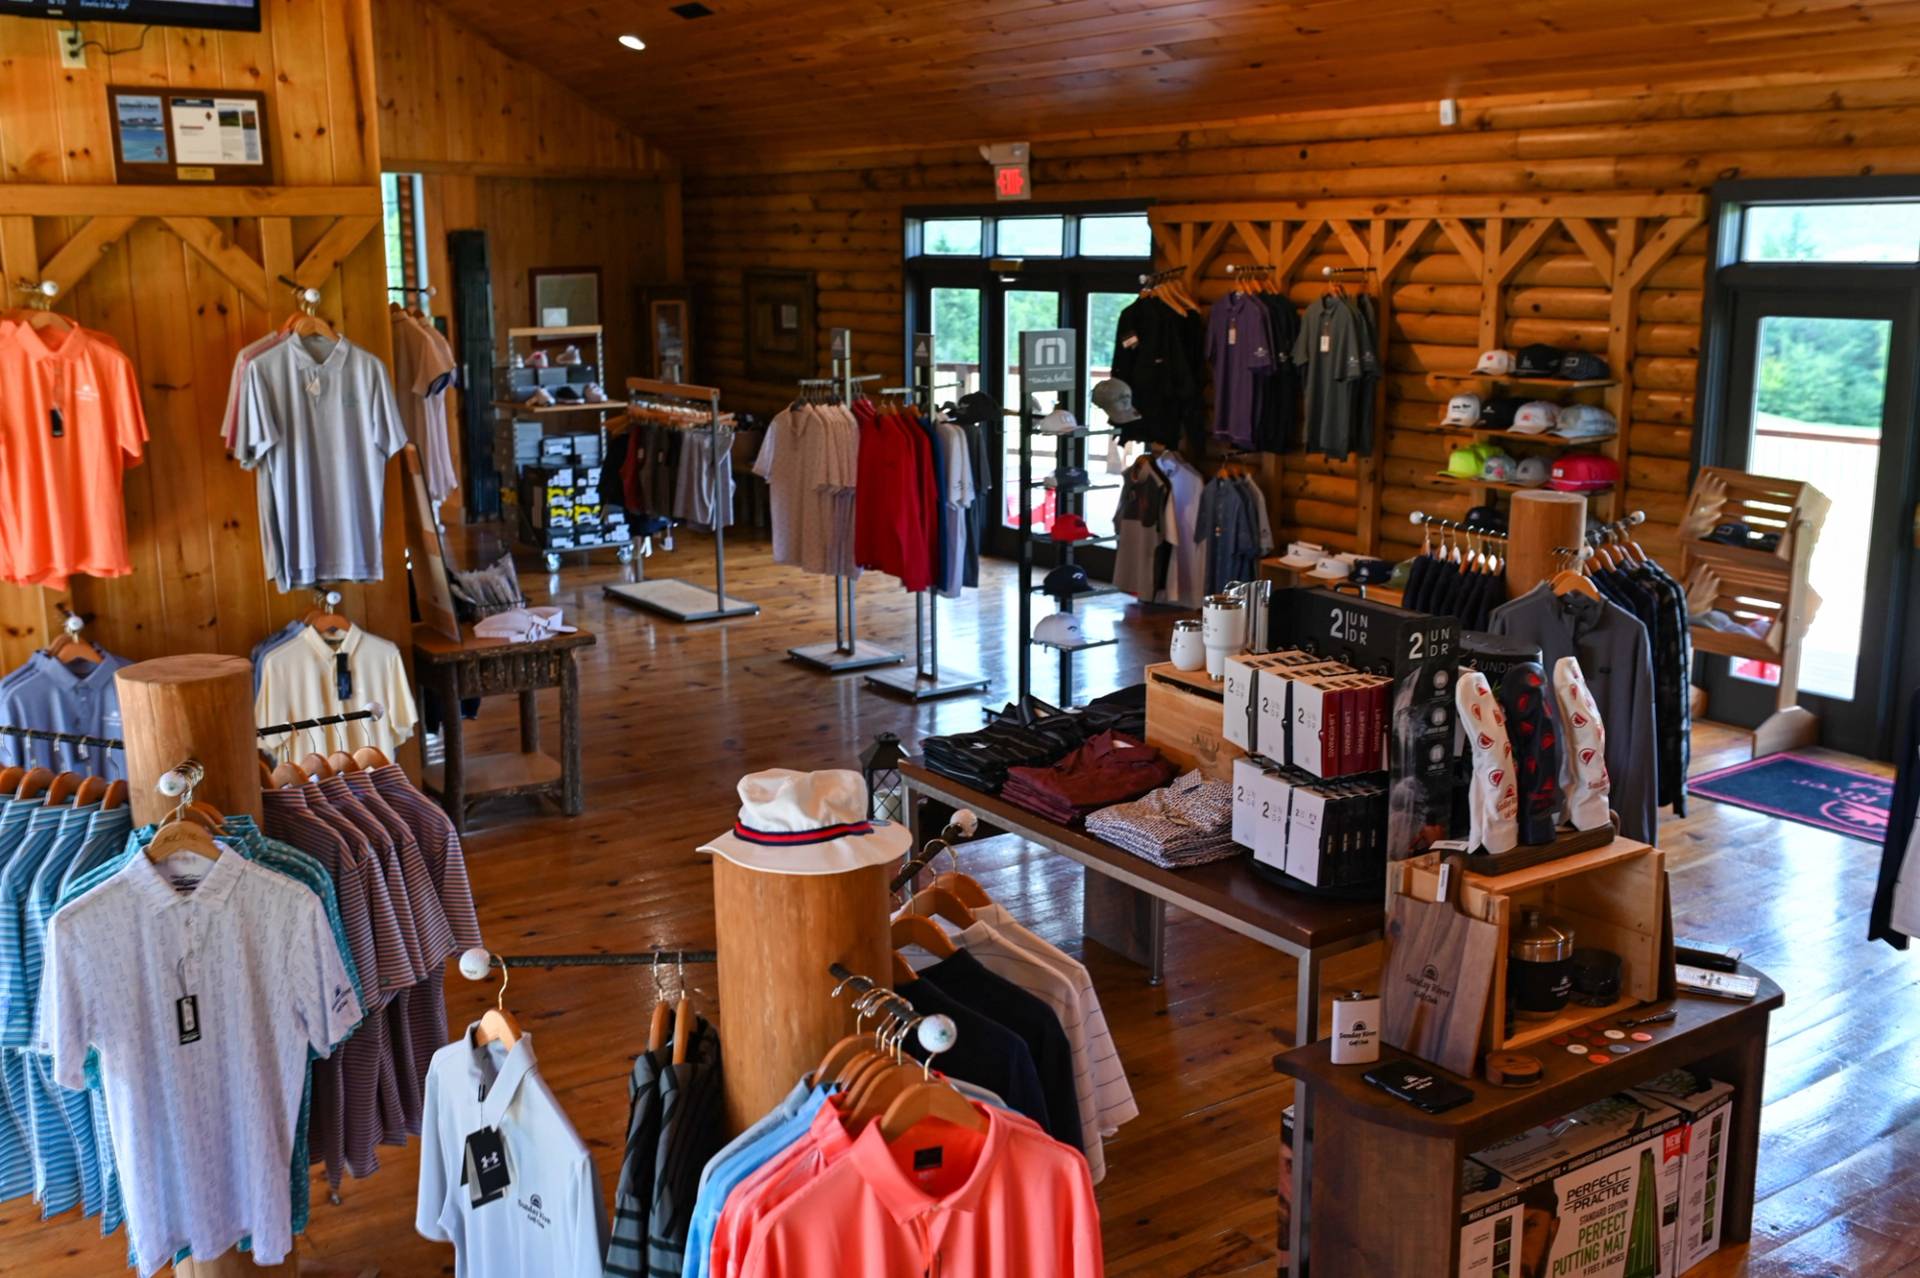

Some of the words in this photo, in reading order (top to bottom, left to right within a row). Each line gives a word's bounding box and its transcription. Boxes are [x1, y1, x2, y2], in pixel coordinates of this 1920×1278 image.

[1330, 608, 1344, 639] 2
[1408, 632, 1423, 660] 2
[1567, 1171, 1621, 1201] PERFECT
[1573, 1183, 1630, 1213] PRACTICE
[1579, 1207, 1607, 1225] STANDARD
[1608, 1199, 1628, 1214] EDITION
[1577, 1212, 1628, 1247] PERFECT
[1552, 1244, 1600, 1278] PUTTING
[1603, 1231, 1626, 1257] MAT
